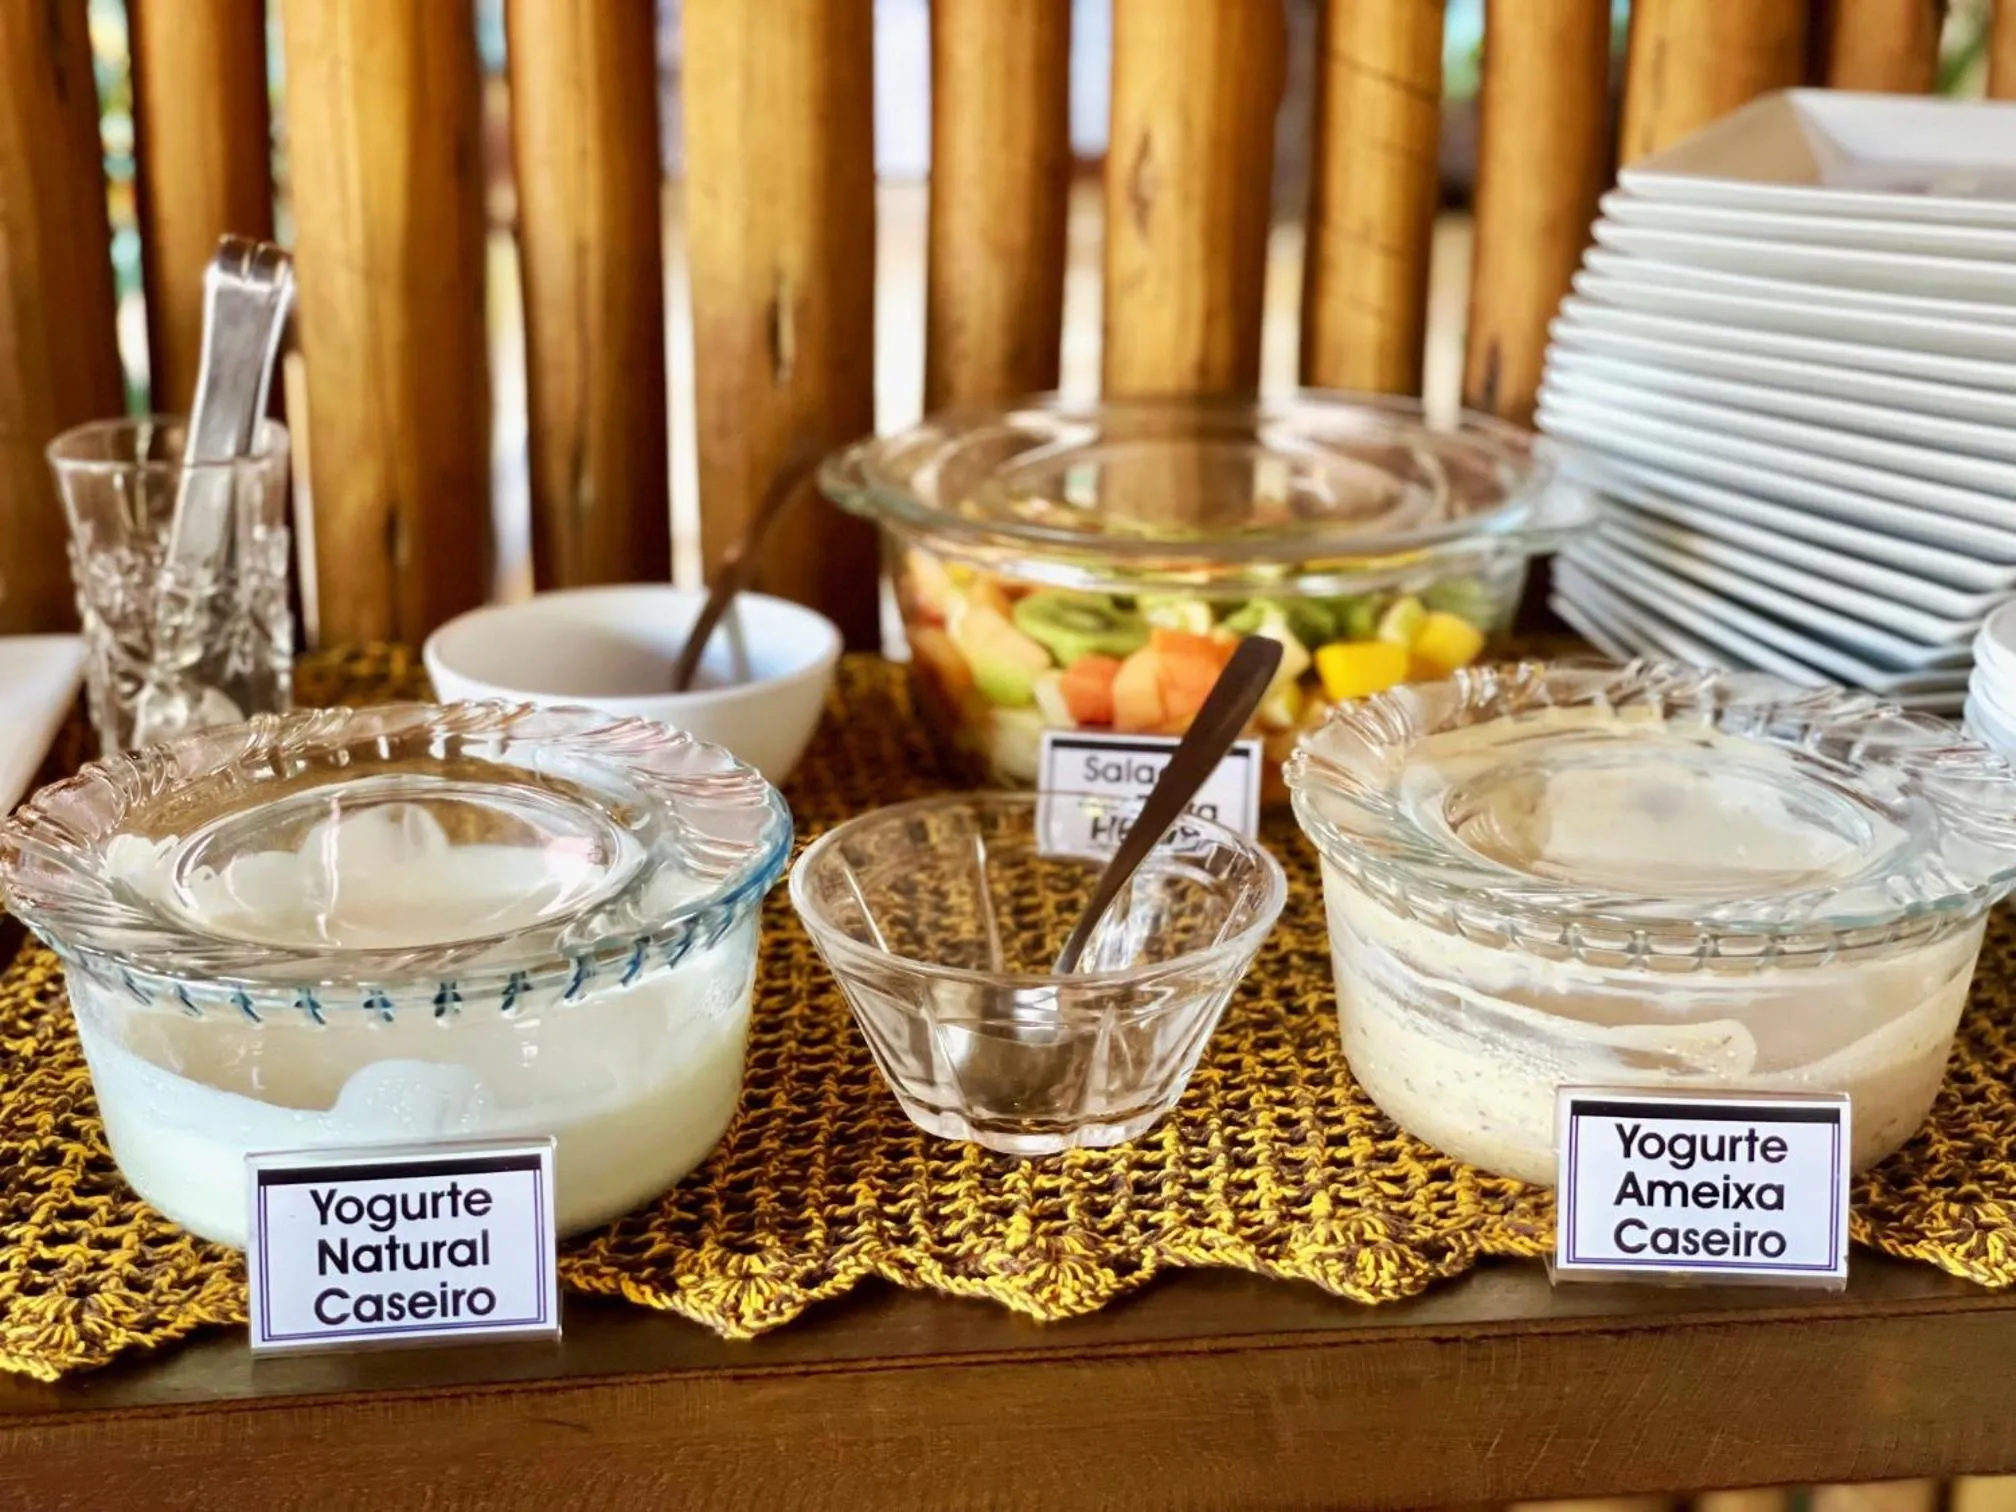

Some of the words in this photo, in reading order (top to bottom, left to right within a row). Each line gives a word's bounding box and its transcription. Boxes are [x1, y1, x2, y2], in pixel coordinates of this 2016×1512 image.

[1084, 755, 1170, 785] Sala
[1613, 1123, 1789, 1170] Yogurte
[309, 1181, 493, 1232] Yogurte
[1613, 1170, 1785, 1211] Ameixa
[317, 1229, 490, 1276] Natural
[1612, 1221, 1787, 1259] Caseiro
[313, 1281, 497, 1326] Caseiro
